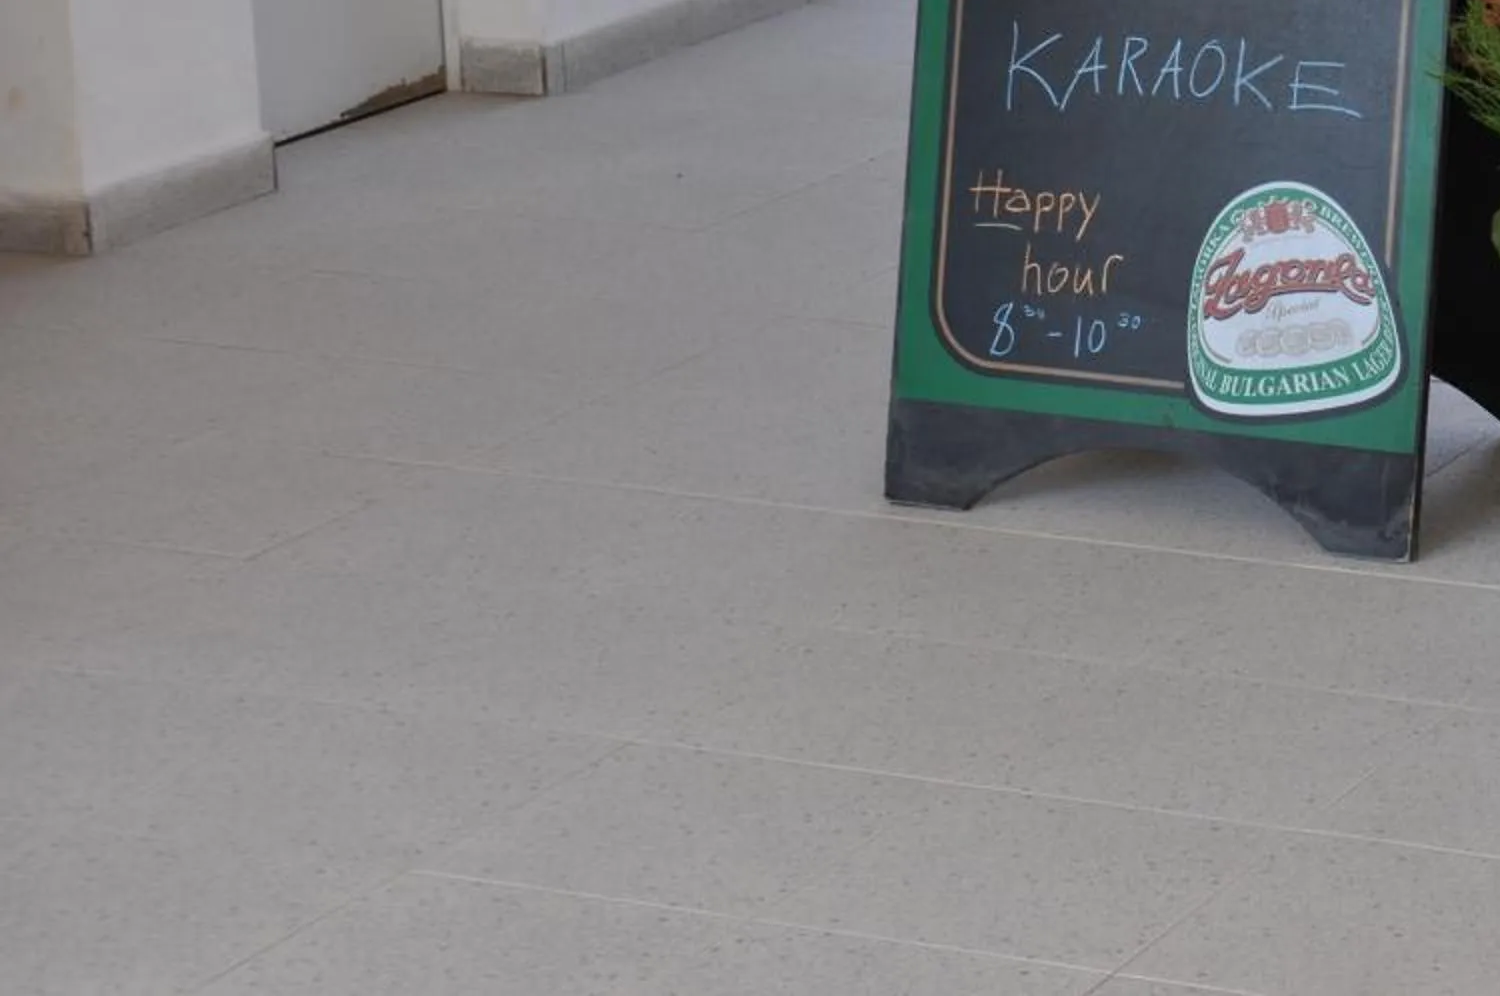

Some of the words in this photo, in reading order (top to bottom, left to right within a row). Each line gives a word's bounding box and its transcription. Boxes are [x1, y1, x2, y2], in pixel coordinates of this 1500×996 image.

[1007, 21, 1362, 118] KARAOKE
[969, 168, 1100, 241] Happy
[1021, 241, 1124, 296] hour
[1218, 366, 1351, 397] BULGARIAN
